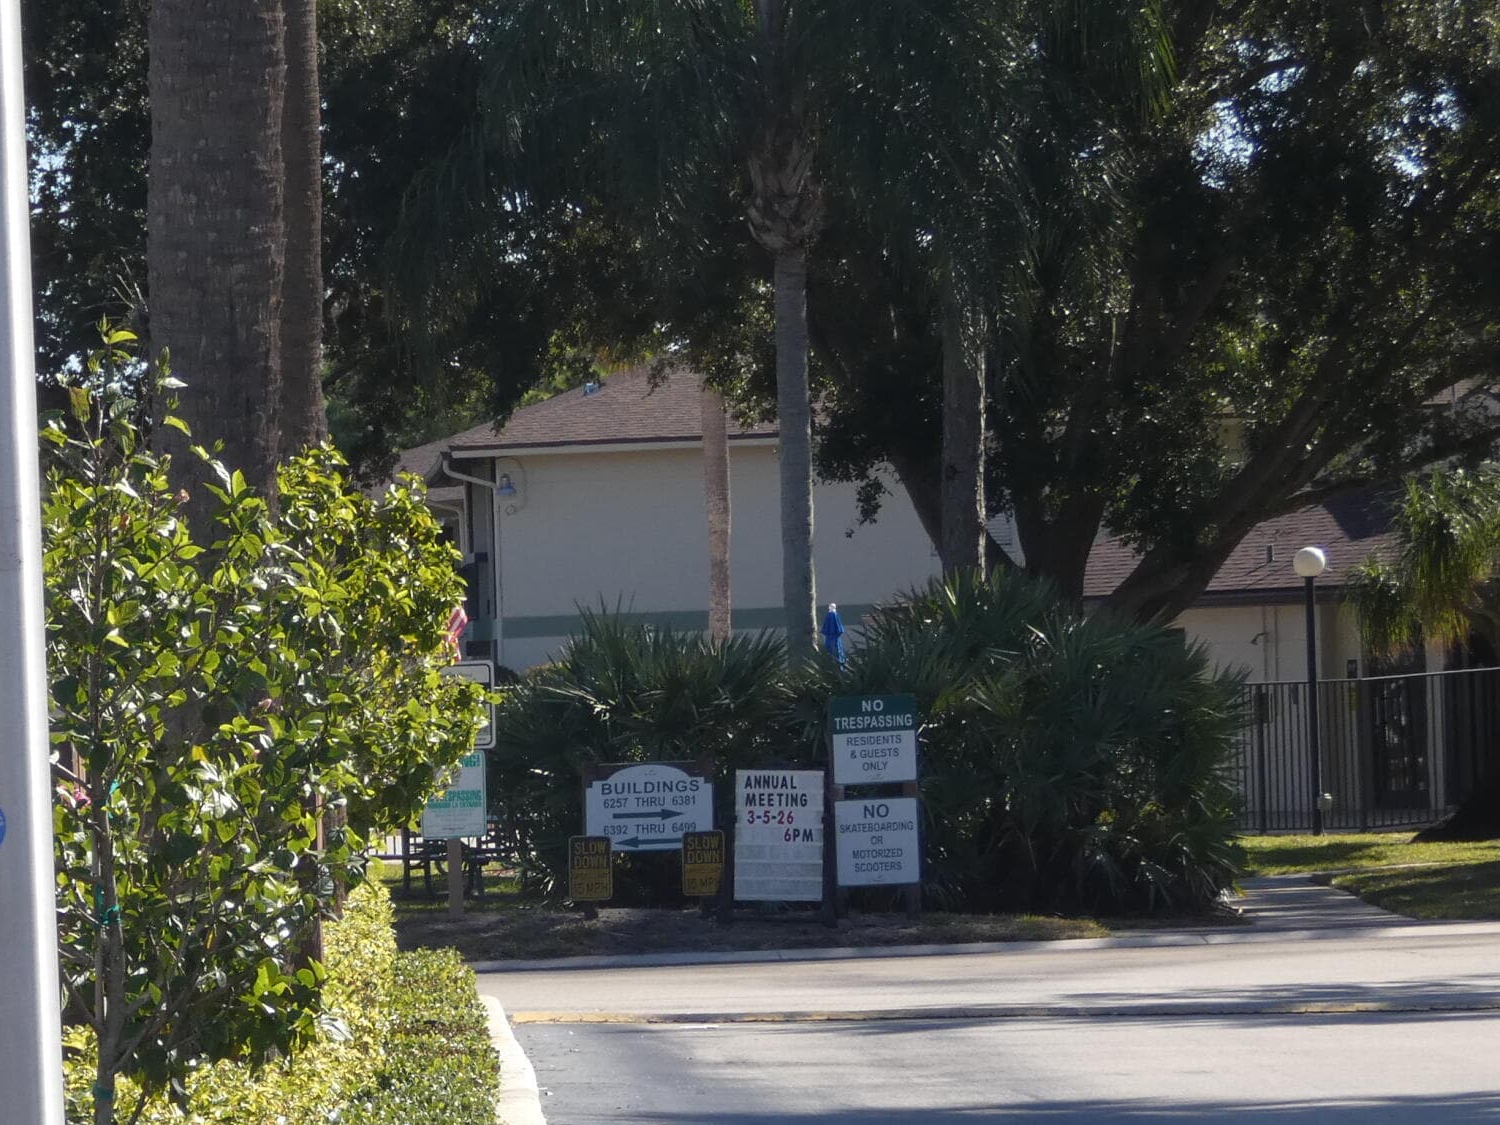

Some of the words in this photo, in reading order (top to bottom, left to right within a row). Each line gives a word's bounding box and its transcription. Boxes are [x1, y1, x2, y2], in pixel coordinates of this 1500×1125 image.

[861, 699, 884, 712] NO
[834, 713, 912, 730] TRESPASSING
[846, 734, 902, 746] RESIDENTS
[850, 749, 857, 759] &
[860, 747, 899, 759] GUESTS
[862, 761, 888, 771] ONLY
[601, 779, 700, 795] BUILDINGS
[744, 775, 797, 789] ANNUAL
[603, 798, 628, 809] 6257
[635, 796, 665, 807] THRU
[672, 794, 696, 806] 6381
[745, 793, 808, 807] MEETING
[747, 811, 794, 824] 3-5-26
[863, 804, 889, 819] NO
[603, 824, 628, 835] 6392
[635, 823, 665, 834] THRU
[672, 822, 696, 833] 6499
[840, 821, 914, 833] SKATEBOARDING
[784, 828, 813, 842] 6PM
[870, 835, 883, 845] OR
[574, 841, 607, 855] SLOW
[687, 836, 719, 850] SLOW
[687, 851, 720, 863] DOWN
[852, 848, 903, 859] MOTORIZED
[574, 855, 607, 869] DOWN
[854, 861, 902, 872] SCOOTERS
